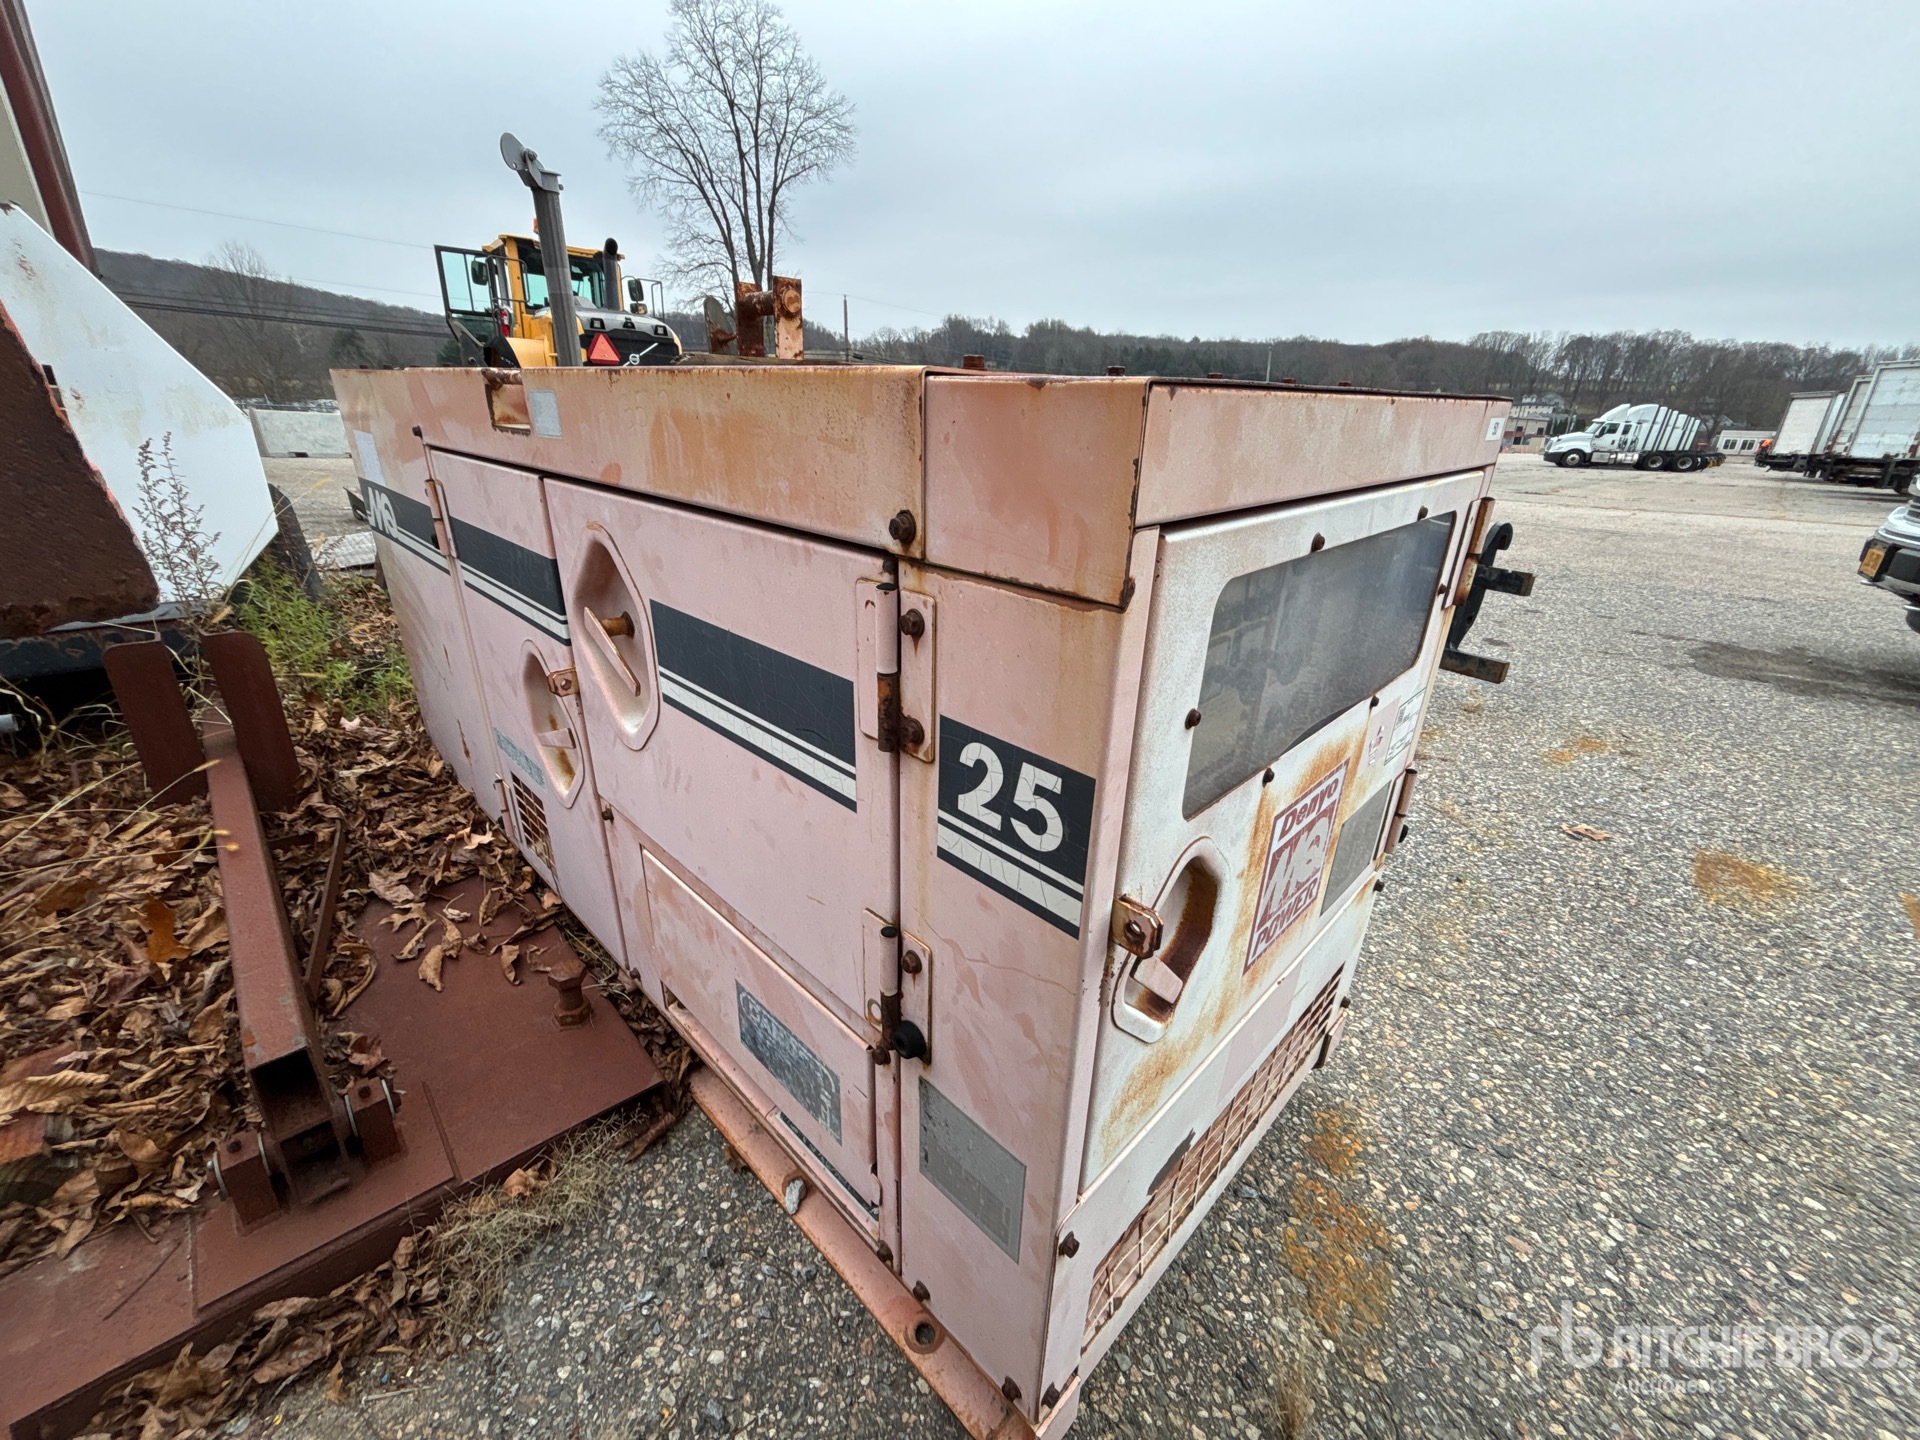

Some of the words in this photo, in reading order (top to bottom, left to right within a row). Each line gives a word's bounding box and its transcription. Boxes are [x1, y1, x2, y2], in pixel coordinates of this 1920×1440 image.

[957, 742, 1063, 852] 25
[1278, 778, 1339, 842] Denyo
[1253, 877, 1318, 957] POWER
